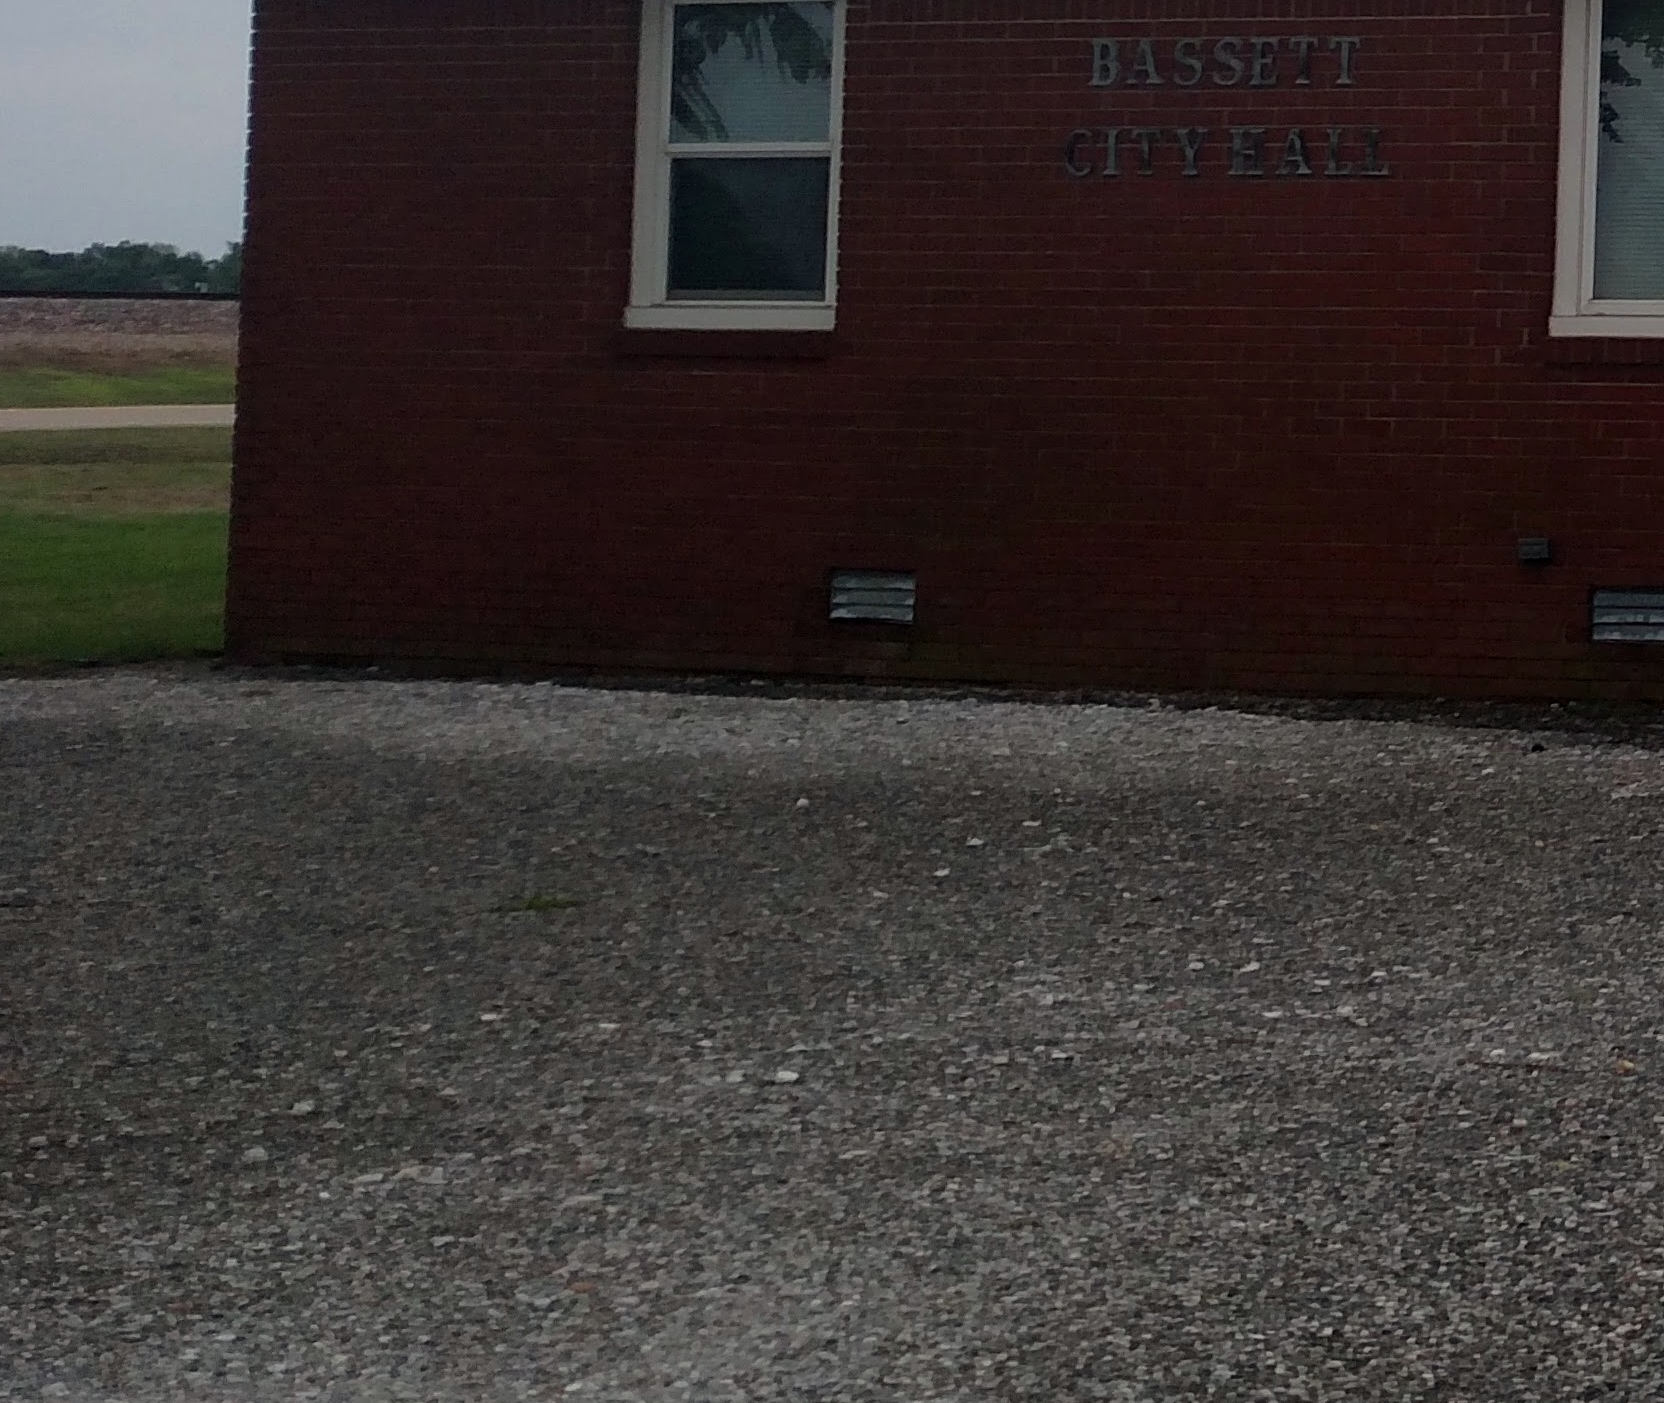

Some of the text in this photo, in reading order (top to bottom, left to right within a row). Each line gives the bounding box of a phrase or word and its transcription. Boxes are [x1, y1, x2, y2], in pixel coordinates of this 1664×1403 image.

[1088, 36, 1361, 87] BASSETT
[1064, 126, 1391, 177] CITY HALL
